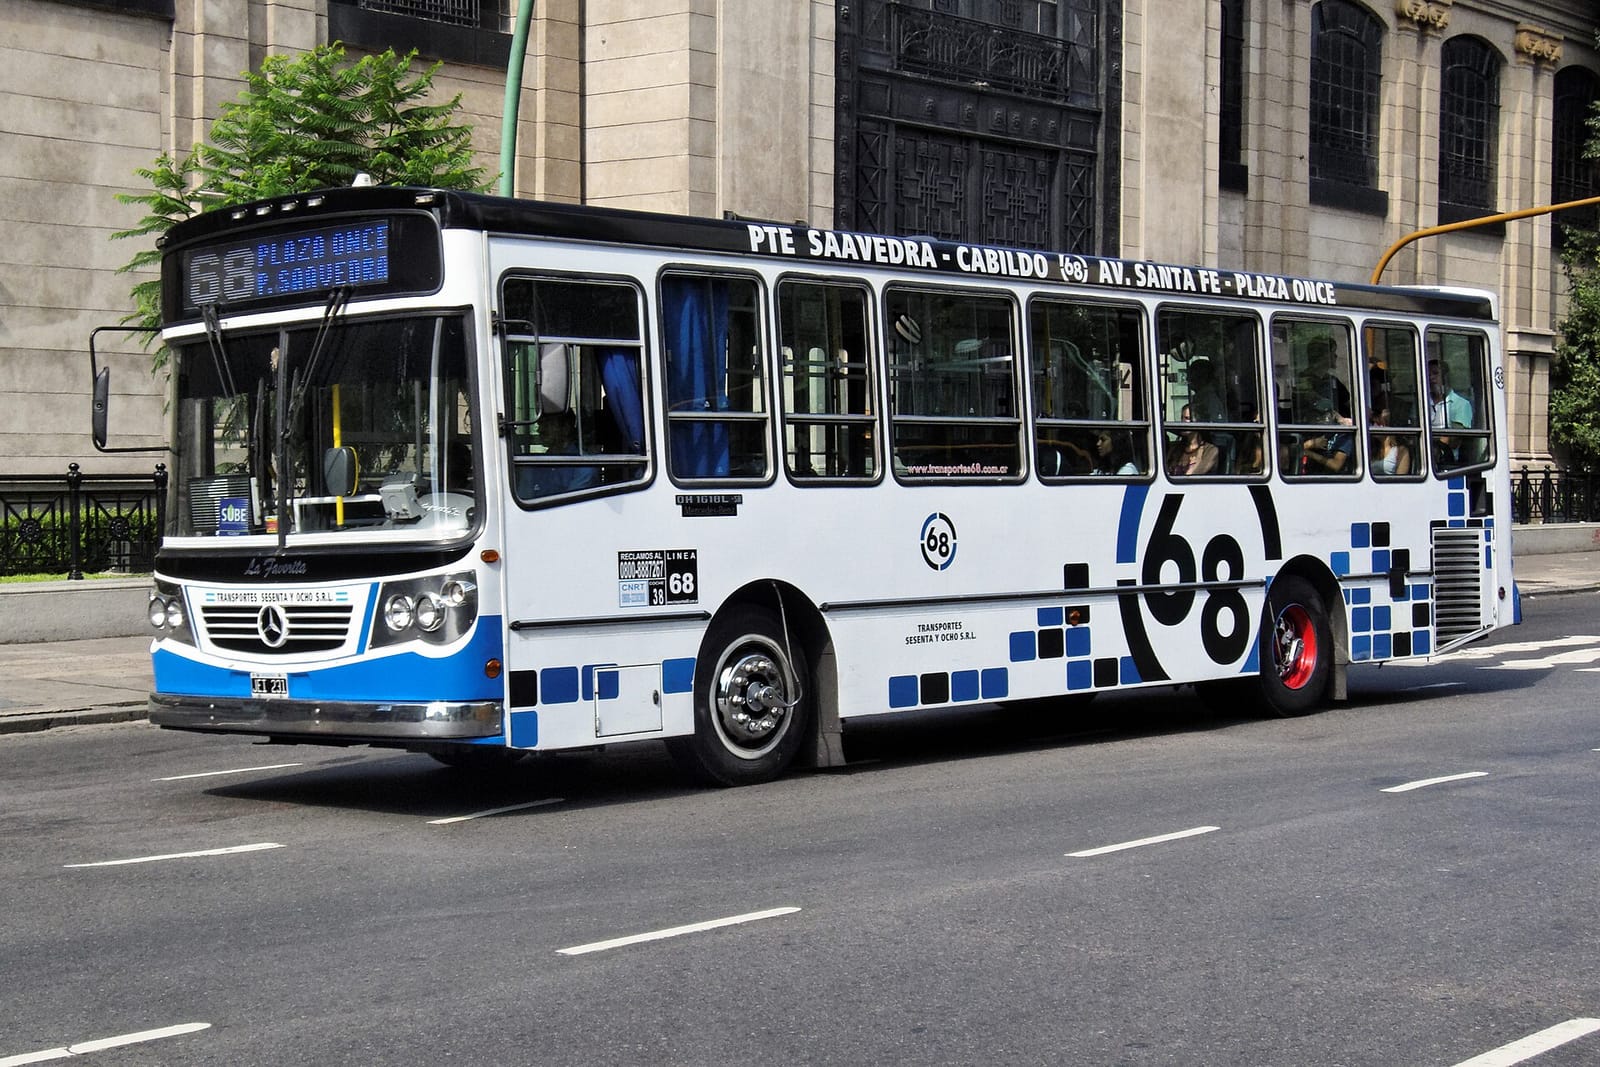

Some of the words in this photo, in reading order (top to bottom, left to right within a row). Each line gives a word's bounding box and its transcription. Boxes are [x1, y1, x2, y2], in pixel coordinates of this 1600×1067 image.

[257, 235, 325, 267] PLAZA
[332, 225, 389, 255] ONCE
[747, 224, 796, 255] PTE
[807, 230, 938, 268] SAAVEDRA
[956, 246, 1049, 279] CABILDO
[1064, 257, 1084, 281] 68
[1099, 260, 1131, 286] AV.
[1135, 263, 1196, 291] SANTA
[1198, 269, 1221, 294] FE
[1234, 273, 1290, 300] PLAZA
[1292, 279, 1337, 305] ONCE
[190, 247, 255, 304] 68
[907, 463, 1008, 476] www.transportes68.com.ar
[221, 504, 248, 522] SUBE
[926, 527, 950, 558] 68
[620, 552, 653, 560] RECLAMOS
[669, 572, 695, 595] 68
[1142, 493, 1250, 665] 68
[217, 592, 258, 602] TRANSPORTES
[261, 592, 288, 602] SESENTA
[296, 592, 313, 602] OCHO
[652, 588, 664, 605] 38
[918, 621, 963, 633] TRANSPORTES
[905, 635, 934, 645] SESENTA
[935, 634, 940, 642] Y
[941, 632, 959, 642] OCHO
[960, 631, 976, 641] S.R.L.
[270, 679, 288, 693] 231
